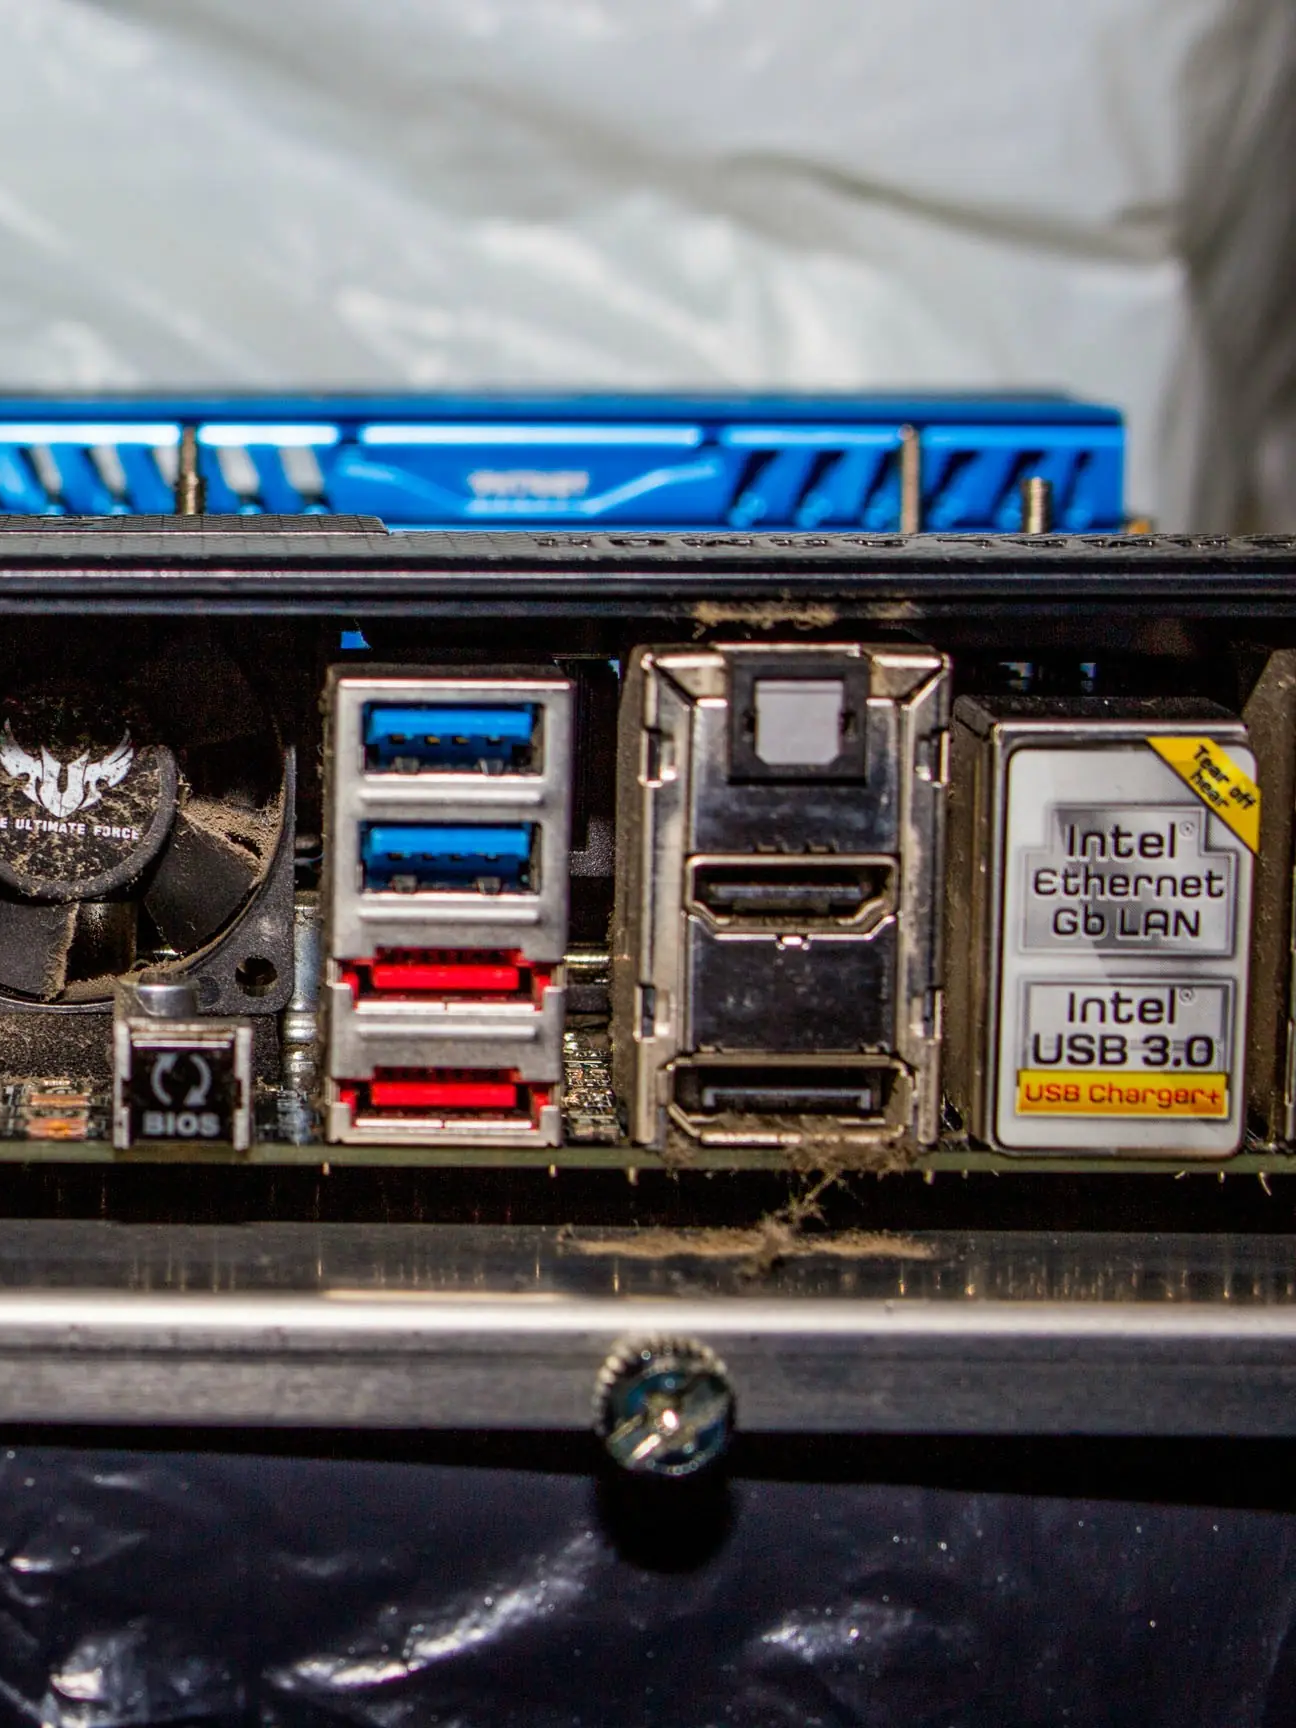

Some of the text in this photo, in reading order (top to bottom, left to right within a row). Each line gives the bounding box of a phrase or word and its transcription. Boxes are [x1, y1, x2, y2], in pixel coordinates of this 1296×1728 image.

[1194, 744, 1257, 810] Tear off
[14, 817, 87, 835] ULTIMATE
[93, 823, 140, 840] FORCE
[1033, 868, 1225, 898] Ethernet
[1053, 909, 1200, 938] Gb LAN
[1031, 1033, 1215, 1068] USB 3.0
[1025, 1082, 1222, 1108] USB Charger+
[141, 1109, 221, 1138] BIOS
